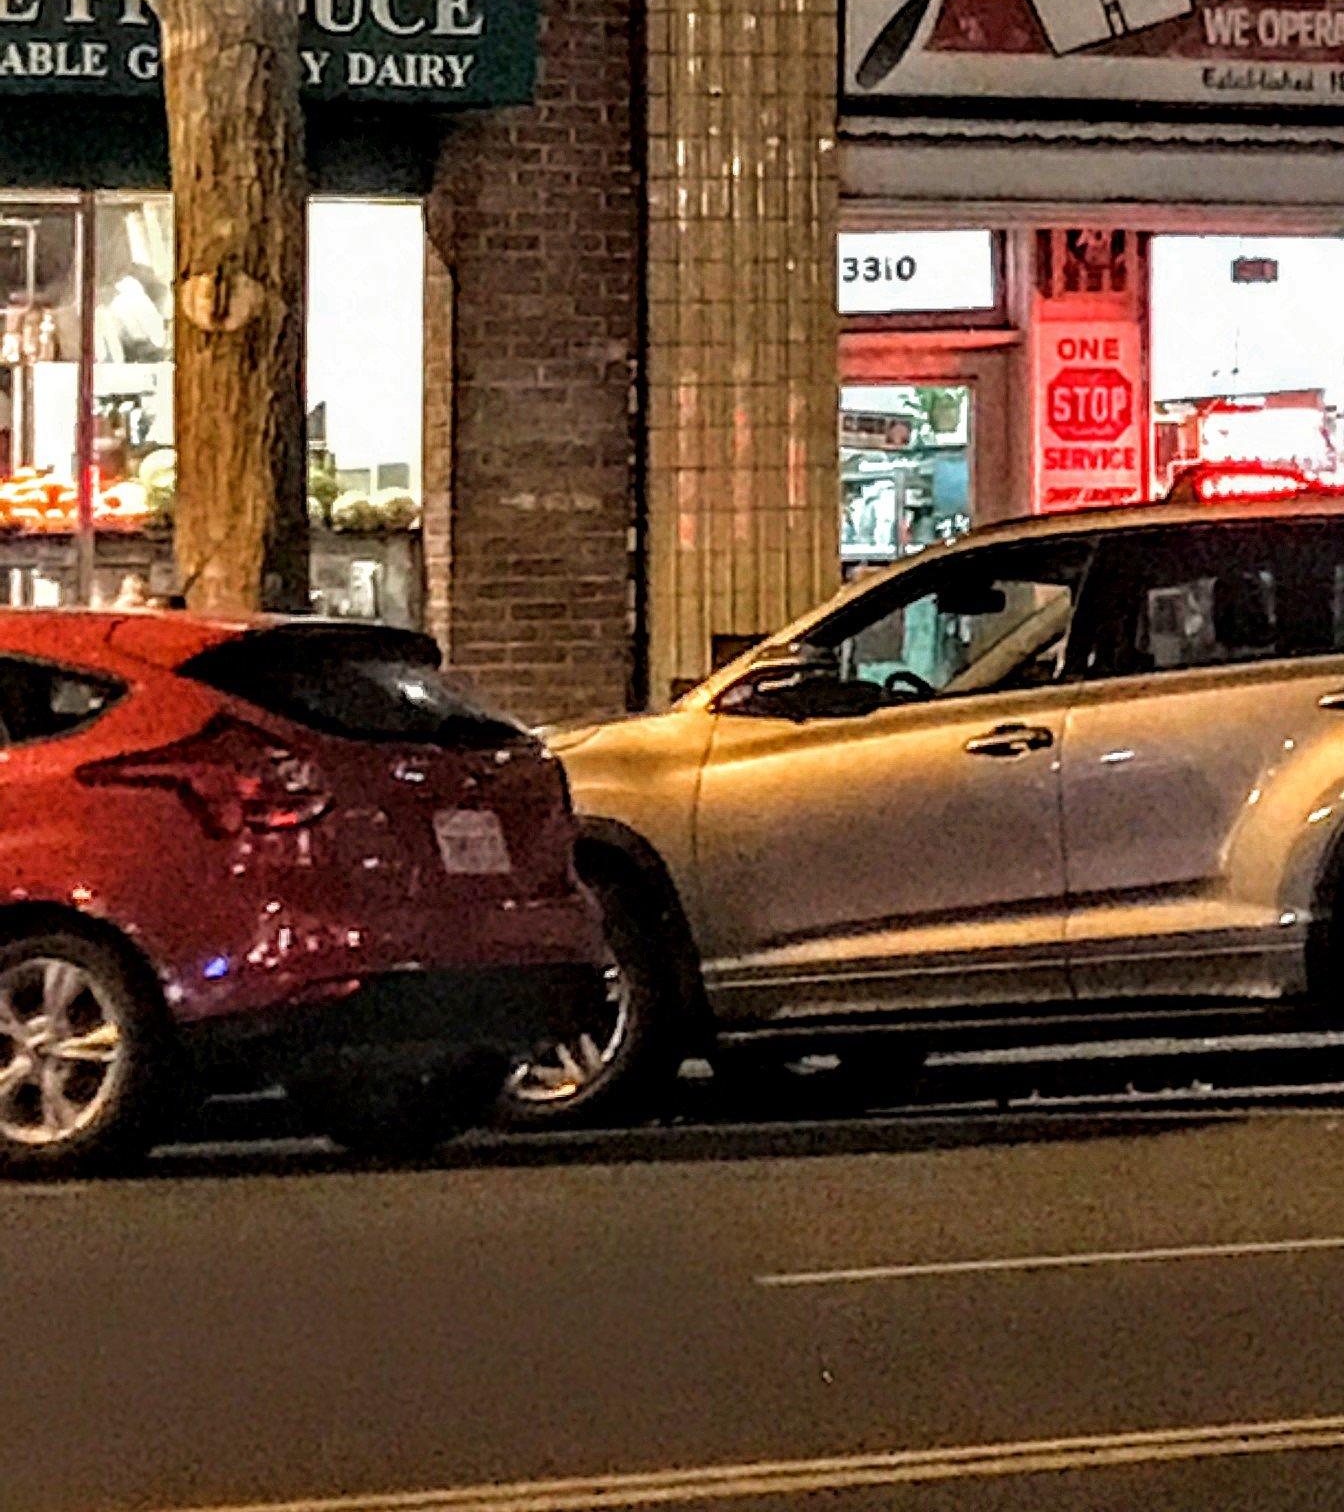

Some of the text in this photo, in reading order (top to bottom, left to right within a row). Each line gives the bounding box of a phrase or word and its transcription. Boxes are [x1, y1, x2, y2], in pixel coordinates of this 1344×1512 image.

[1203, 7, 1250, 46] WE
[347, 52, 475, 89] DAIRY
[1057, 338, 1120, 360] ONE
[1053, 386, 1127, 422] STOP
[1044, 447, 1135, 470] SERVICE
